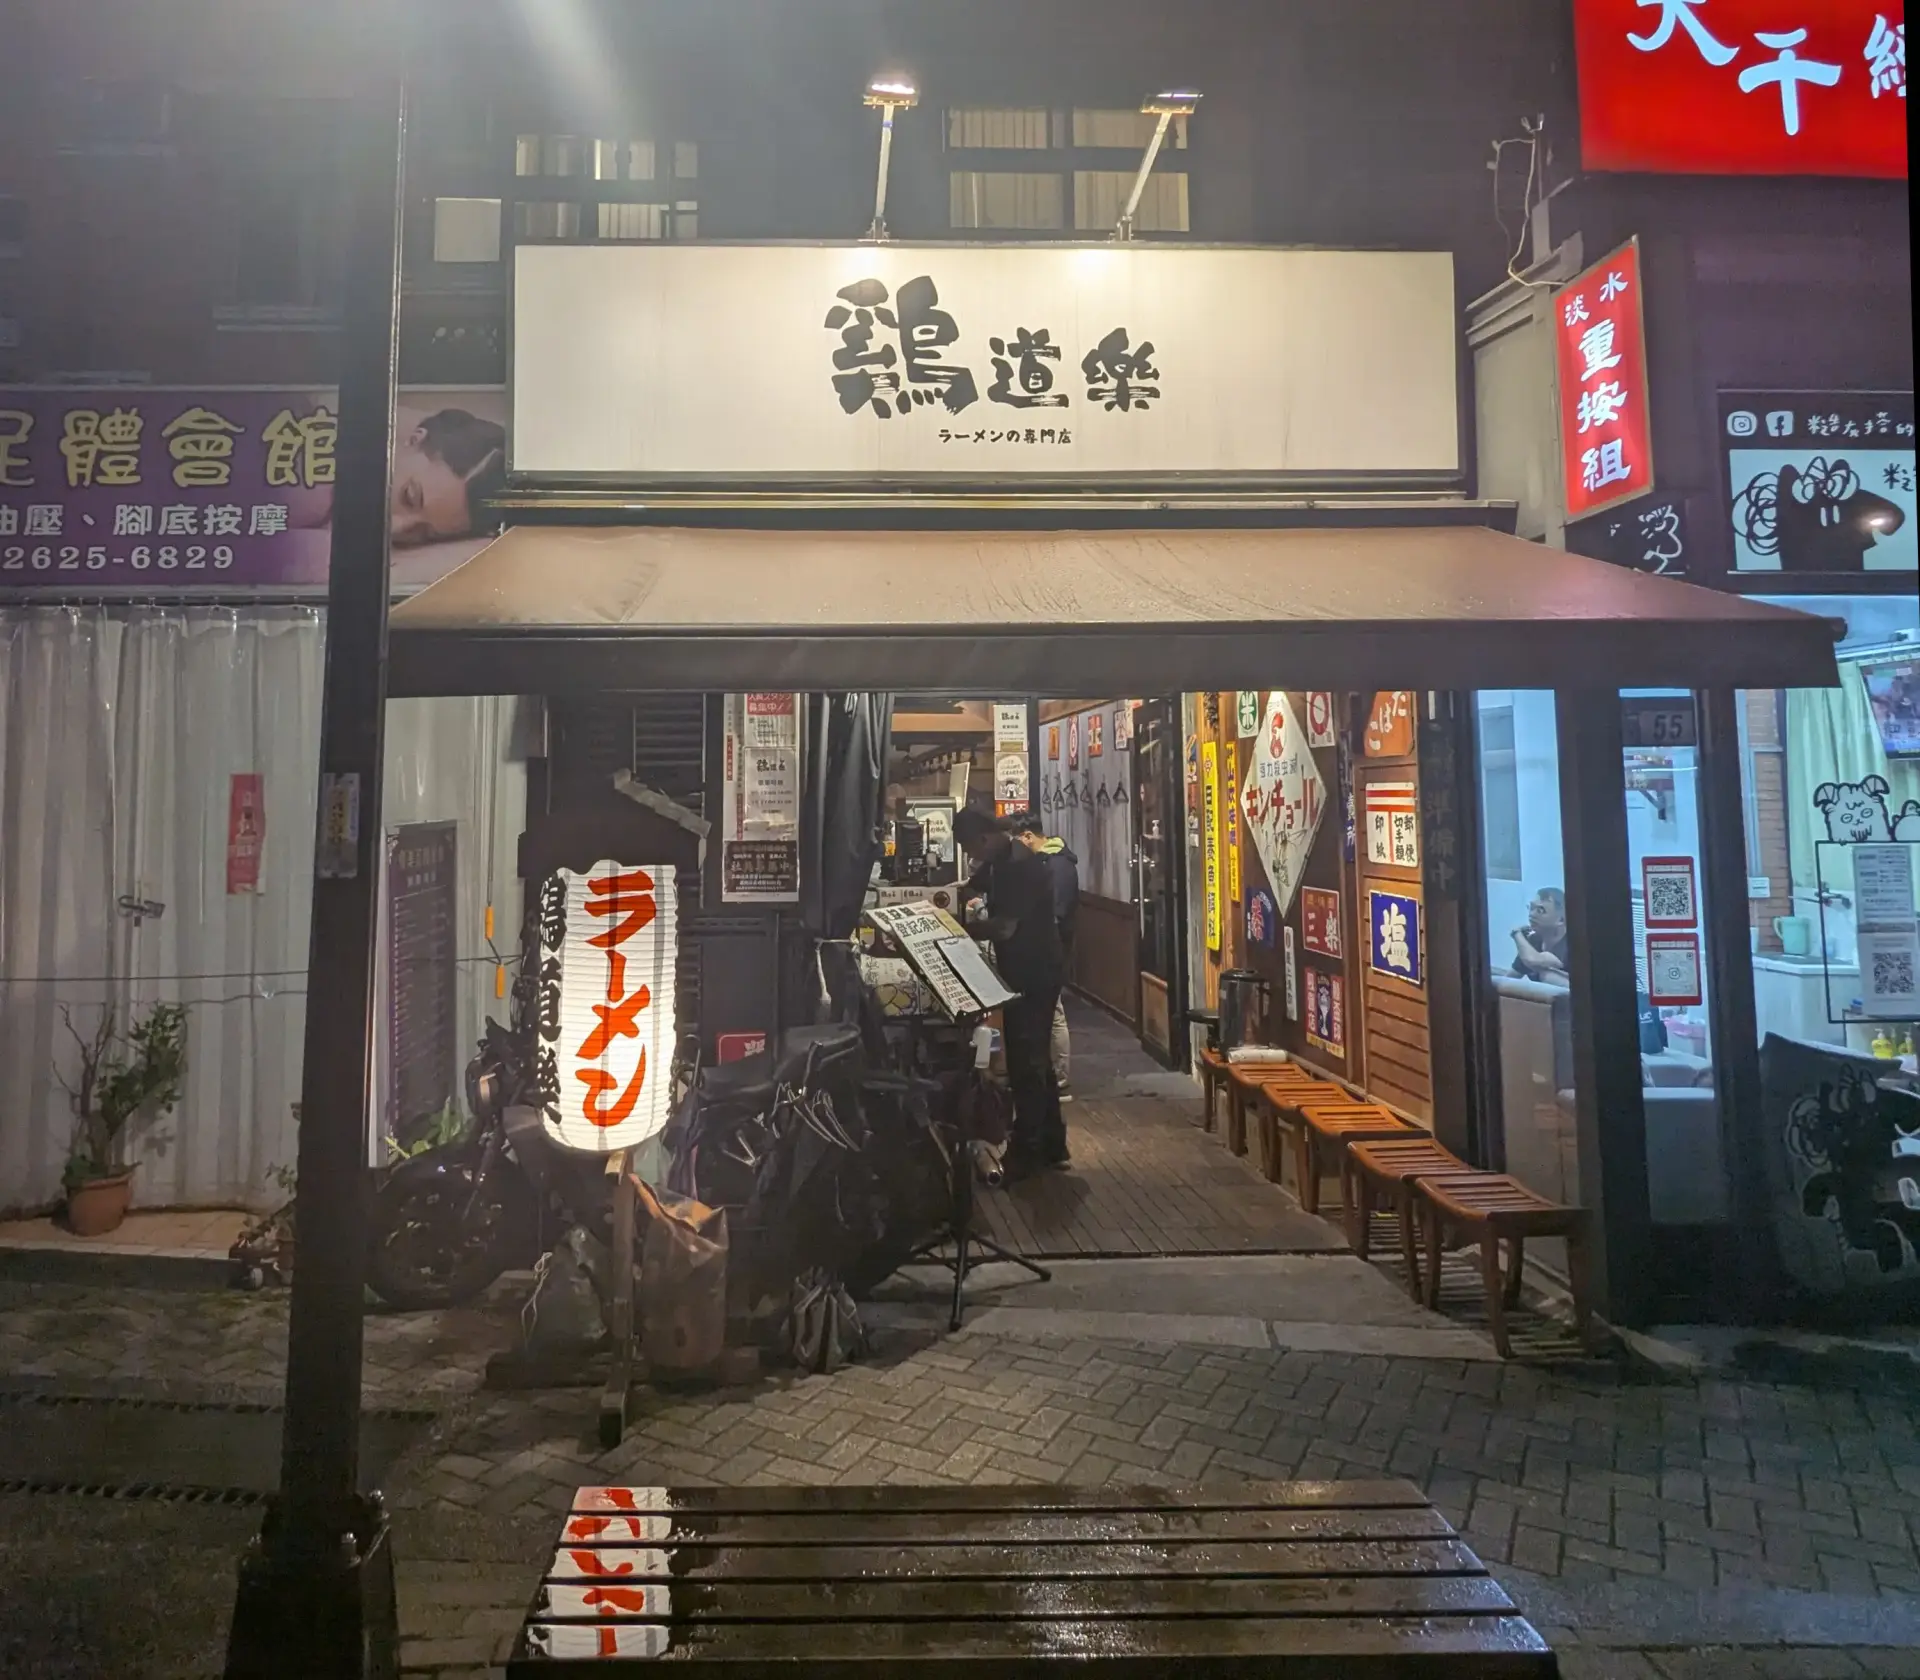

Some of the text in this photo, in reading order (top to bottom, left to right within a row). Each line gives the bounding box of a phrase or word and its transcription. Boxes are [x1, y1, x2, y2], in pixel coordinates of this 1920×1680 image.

[1564, 272, 1628, 327] 淡水
[1578, 319, 1631, 492] 重按組
[3, 546, 235, 570] 2625-6829
[1368, 691, 1407, 750] たばこ
[1653, 713, 1683, 739] 55
[1375, 815, 1387, 858] 印紙
[1394, 816, 1405, 861] 切手類
[1404, 815, 1416, 862] 郵便
[895, 916, 941, 938] 登記須知
[1380, 902, 1411, 972] 塩
[575, 869, 656, 1127] ラーメン
